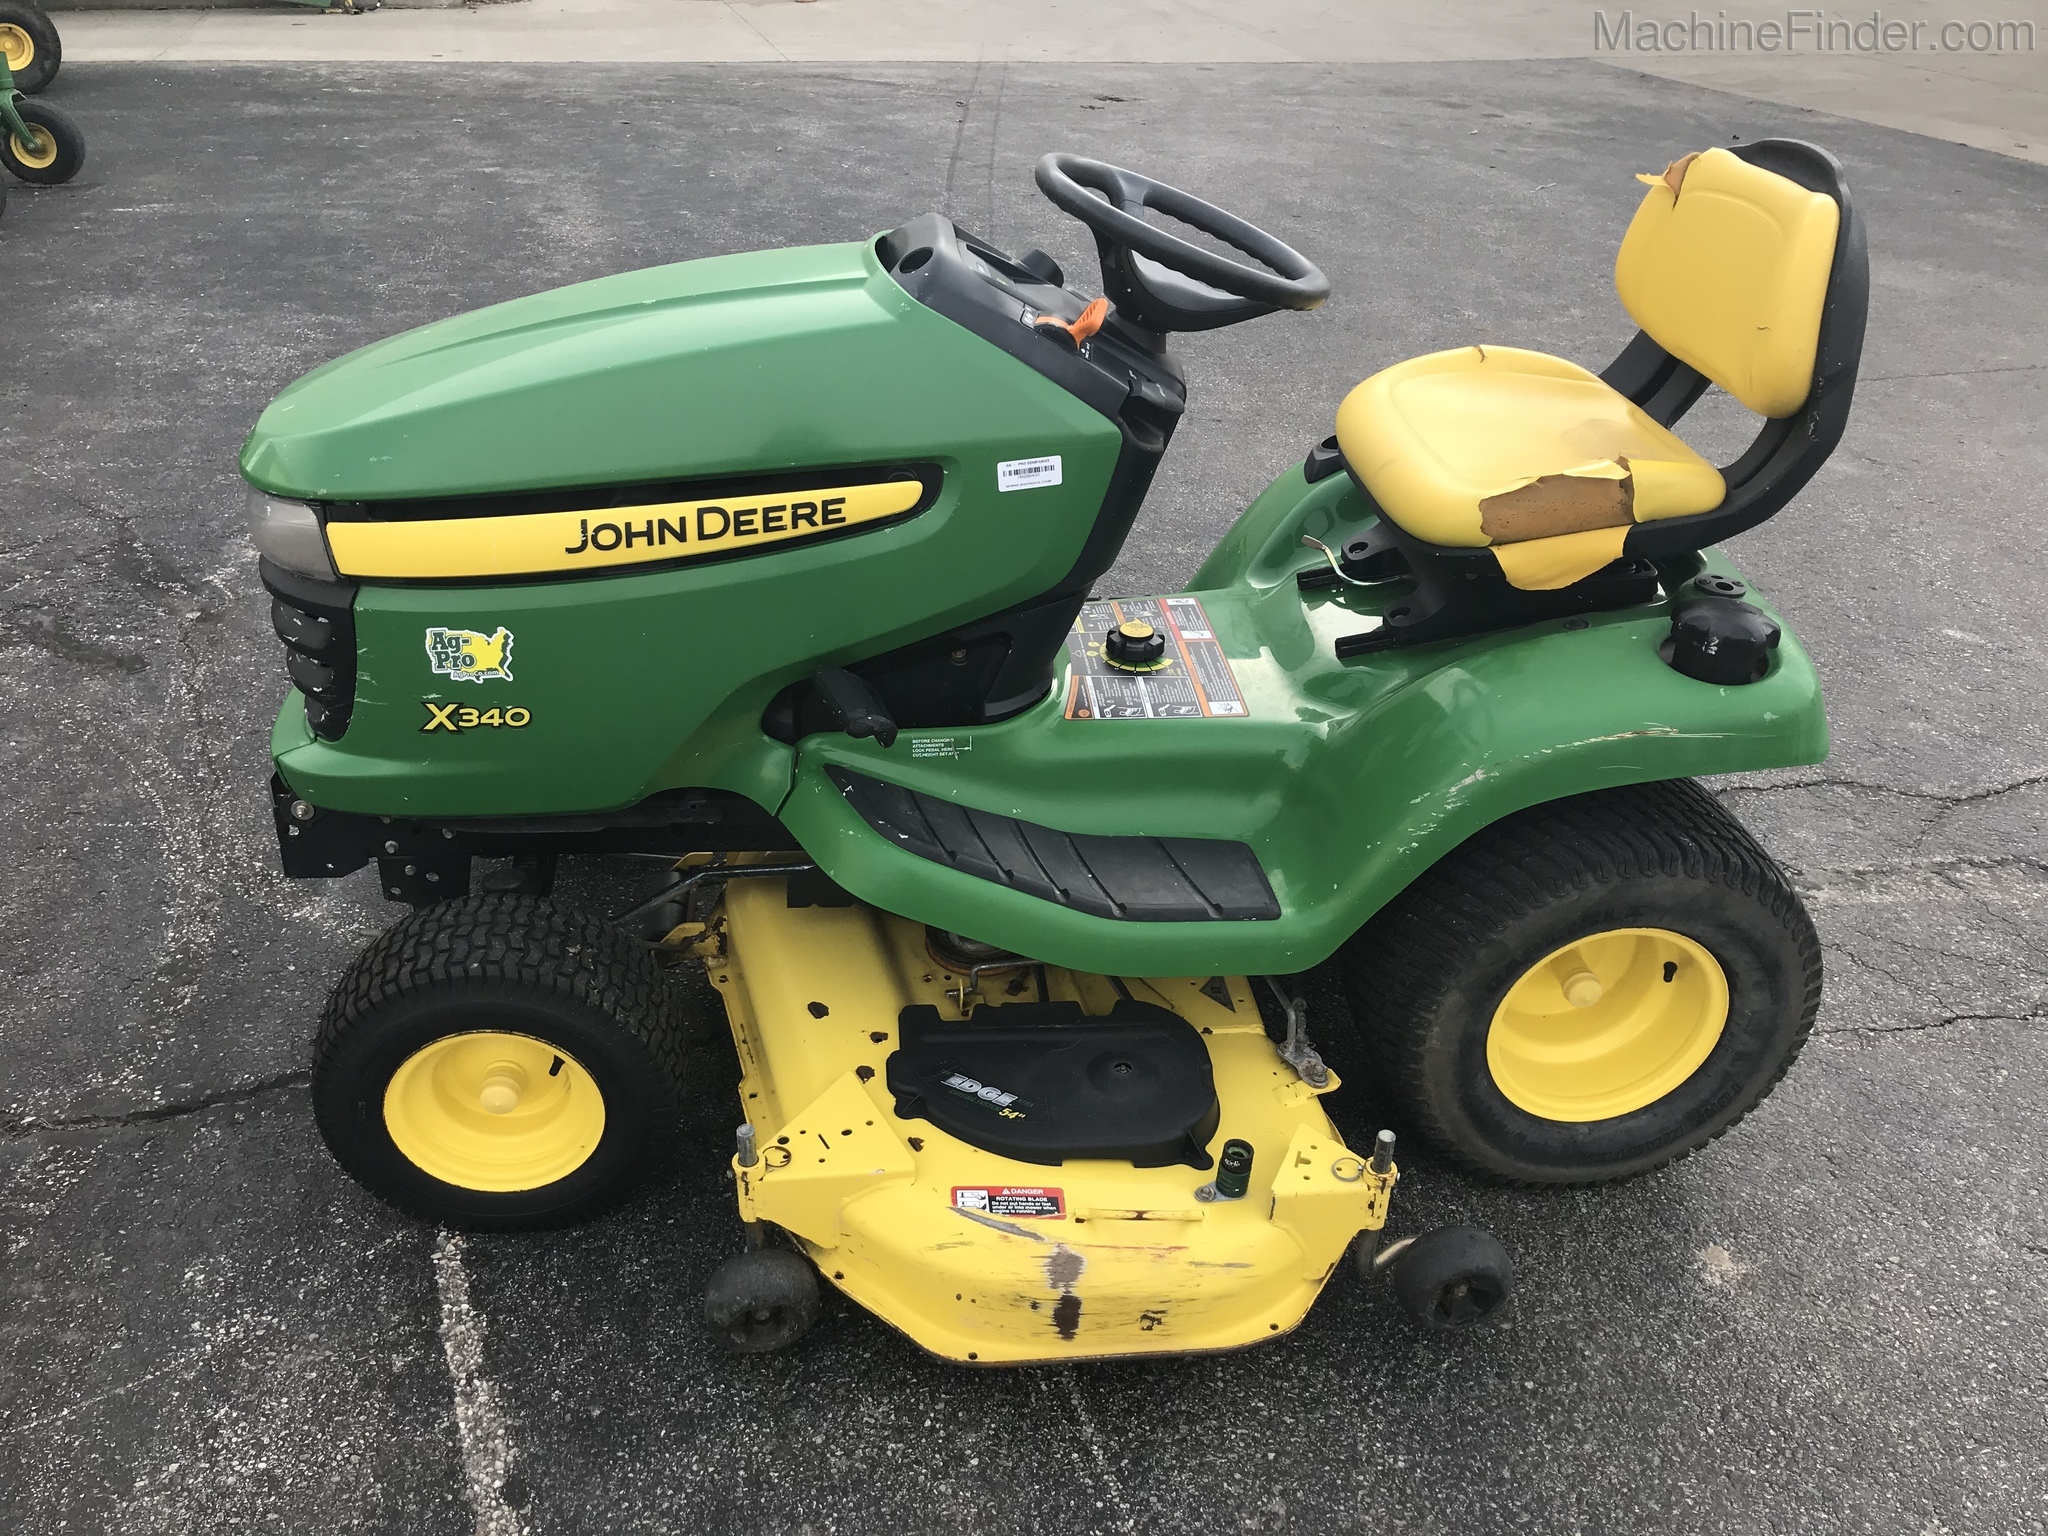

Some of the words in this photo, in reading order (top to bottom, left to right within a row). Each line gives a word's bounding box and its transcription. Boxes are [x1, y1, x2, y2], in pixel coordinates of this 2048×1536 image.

[565, 515, 688, 554] JOHN
[696, 496, 847, 541] DEERE
[431, 631, 471, 654] Ag-
[435, 650, 476, 670] Pro
[421, 702, 532, 732] X340
[940, 1072, 1019, 1107] EDGE
[998, 1107, 1026, 1119] 54"
